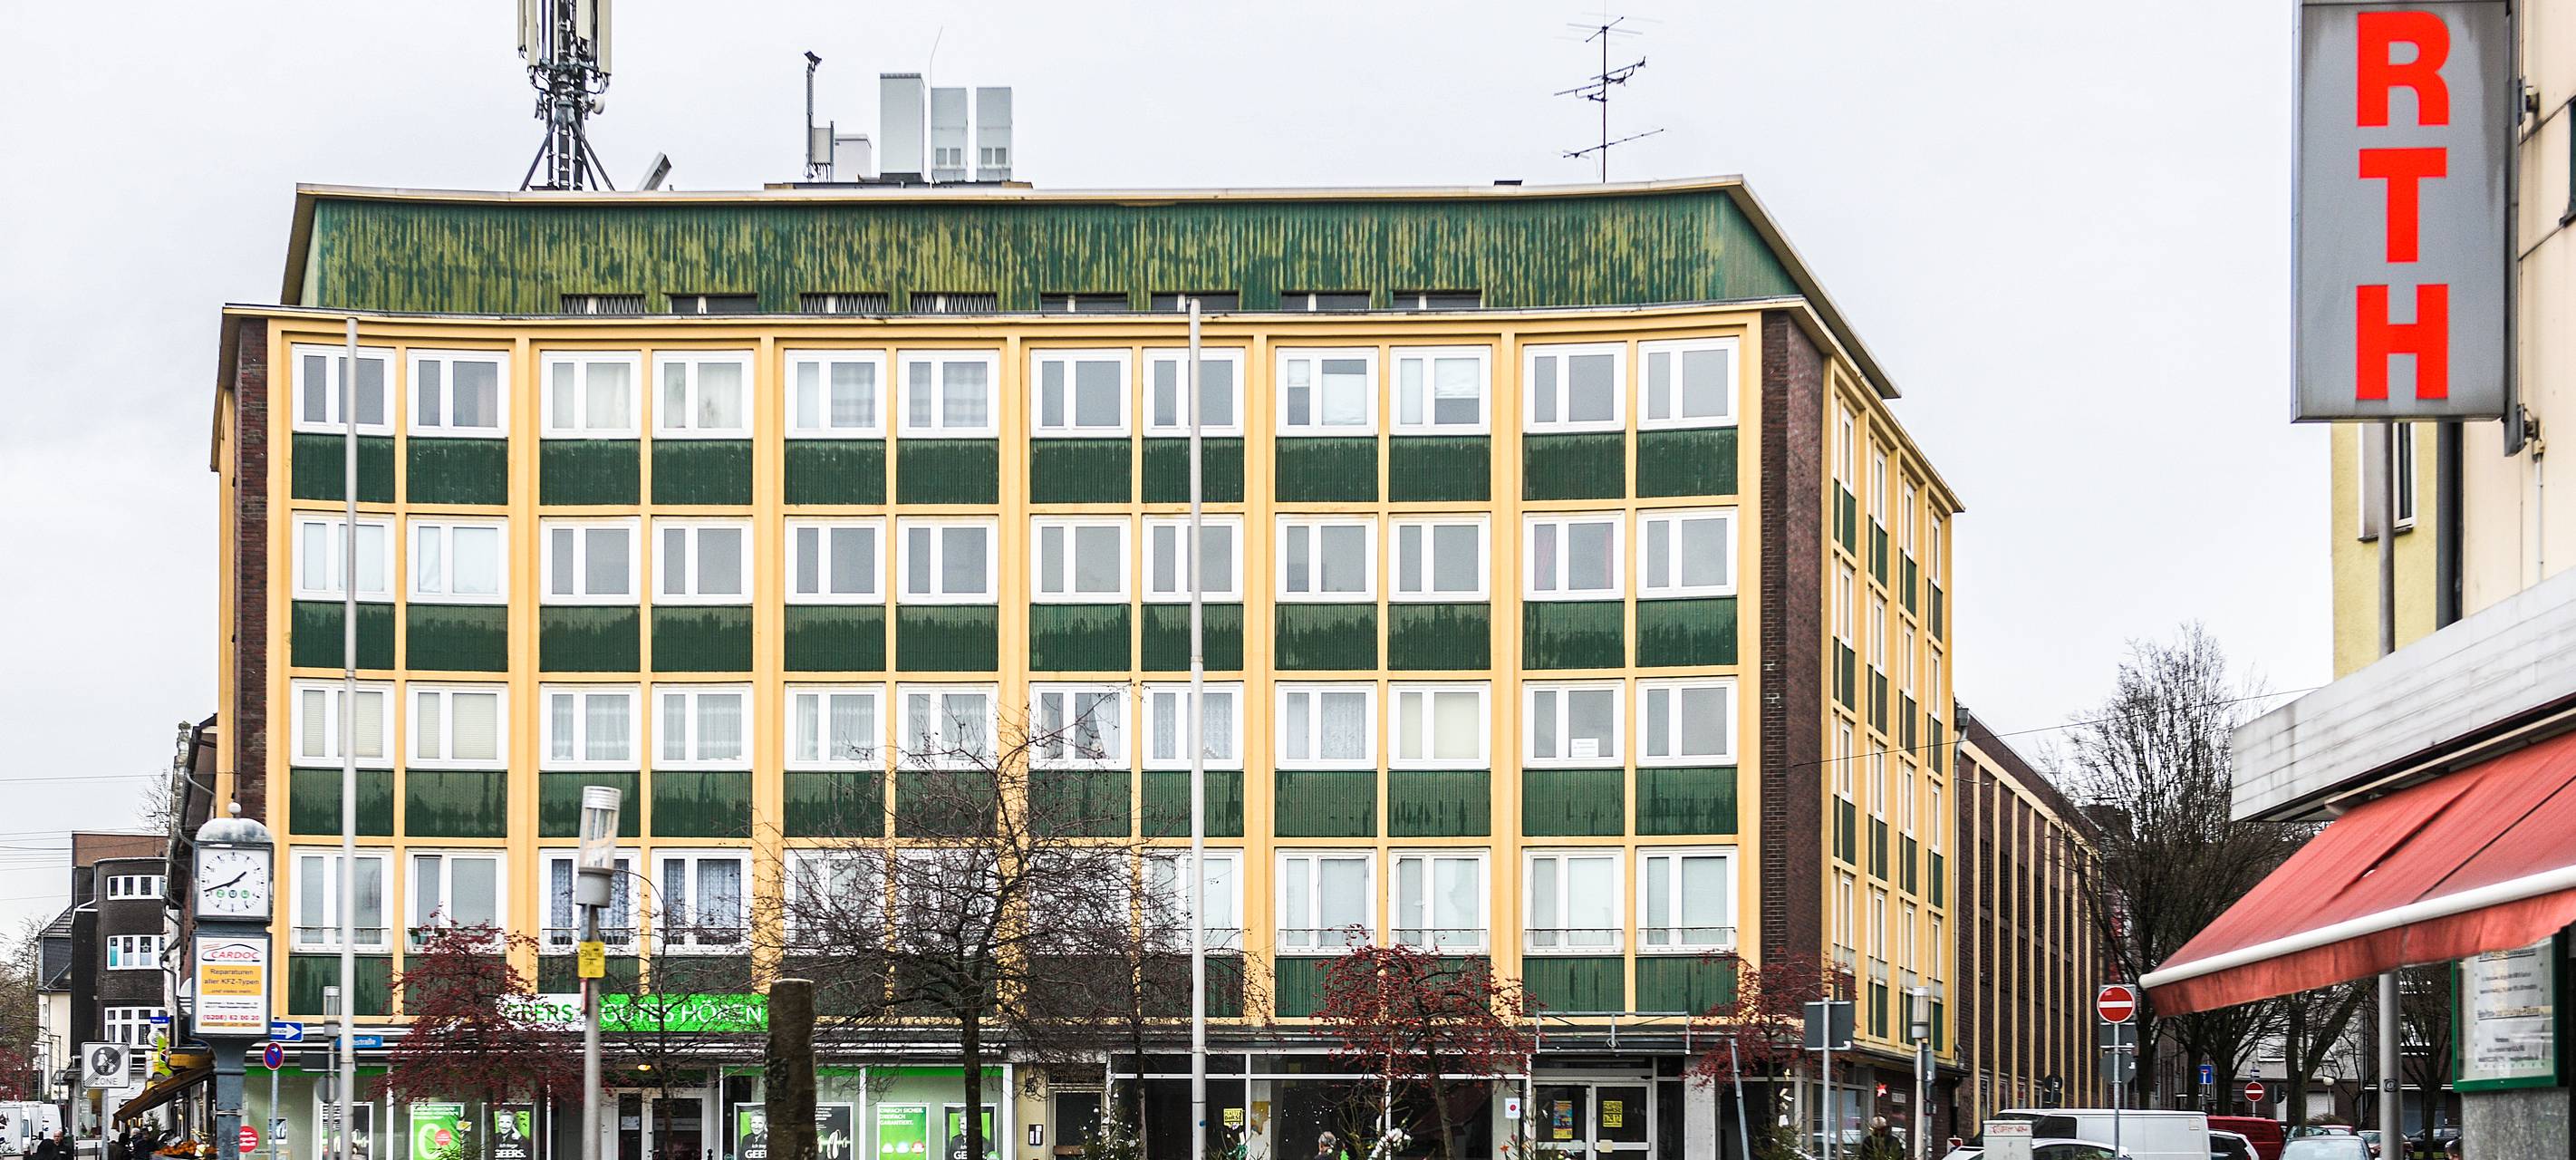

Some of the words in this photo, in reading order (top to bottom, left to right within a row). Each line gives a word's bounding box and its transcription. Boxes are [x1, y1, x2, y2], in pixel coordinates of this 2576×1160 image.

[211, 951, 259, 959] CARDOC
[210, 968, 254, 976] Reparaturen
[221, 978, 259, 986] KFZ-Typen
[601, 1002, 674, 1023] GUTES
[681, 1000, 762, 1022] HÖREN
[94, 1078, 118, 1086] ZONE
